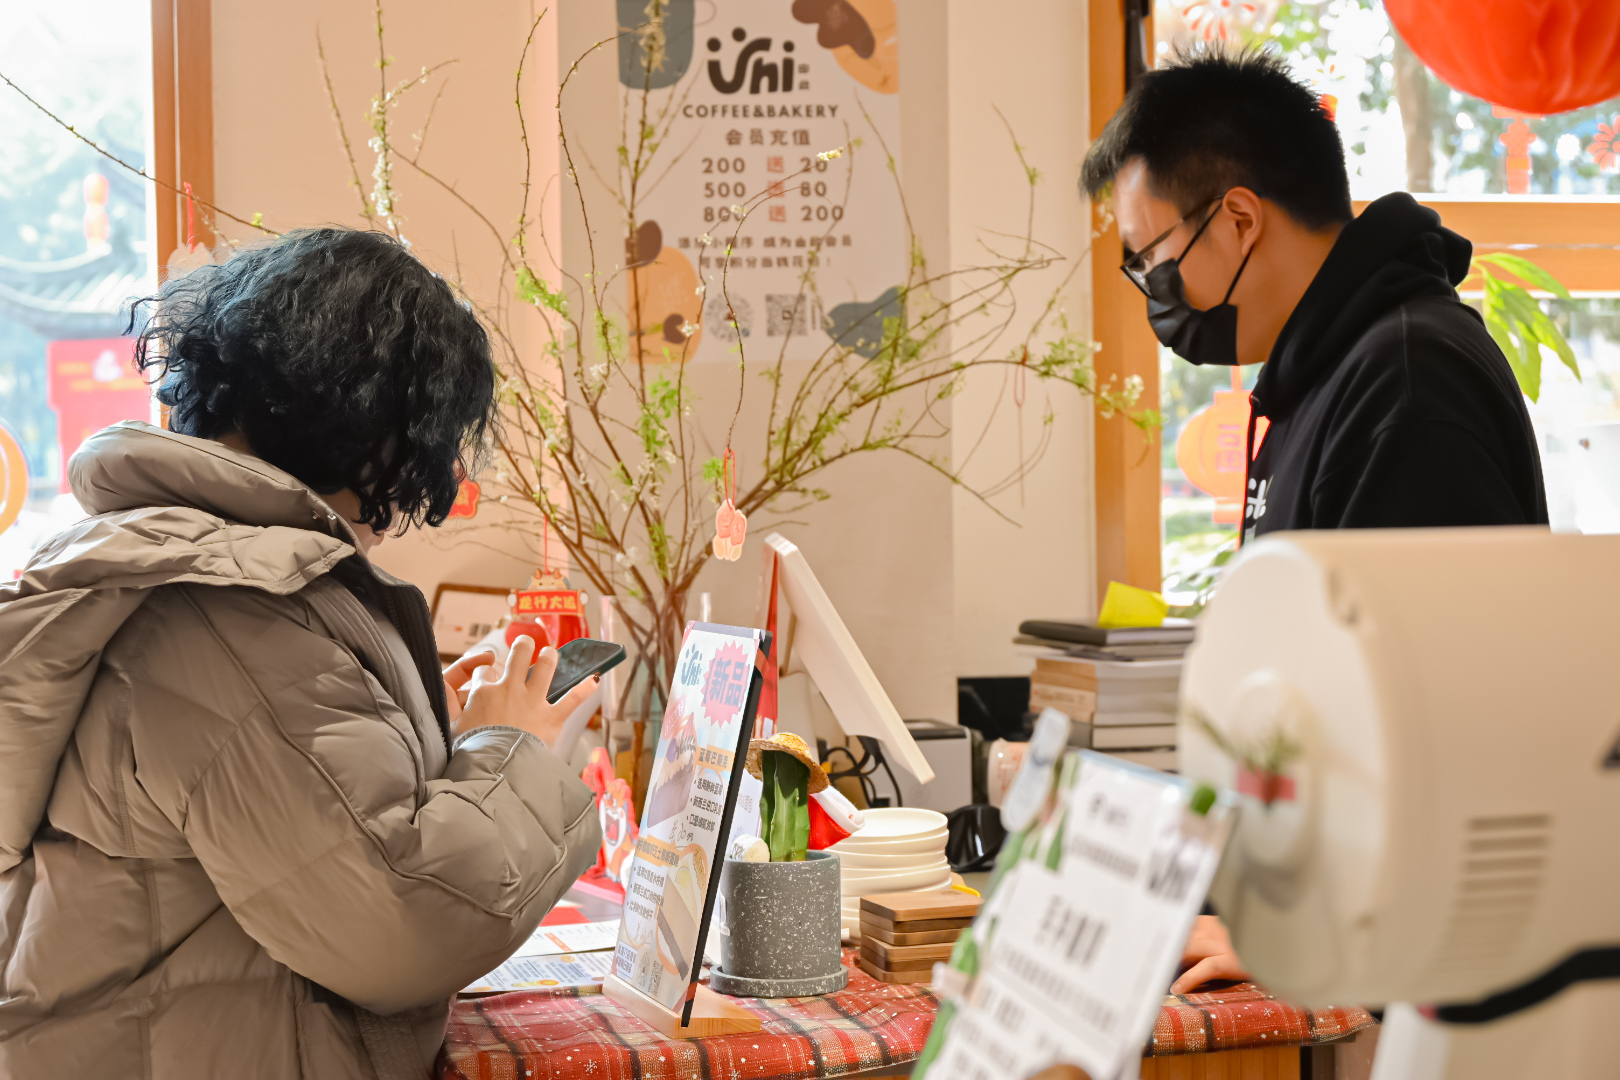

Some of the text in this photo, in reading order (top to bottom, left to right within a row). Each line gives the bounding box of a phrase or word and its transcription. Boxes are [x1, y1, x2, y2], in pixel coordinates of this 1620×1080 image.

[682, 104, 839, 118] COFFEE&BAKERY
[725, 128, 811, 146] 会员充值
[702, 157, 745, 174] 200
[800, 157, 828, 173] 20
[704, 182, 746, 198] 500
[800, 181, 827, 197] 80
[801, 205, 844, 221] 200
